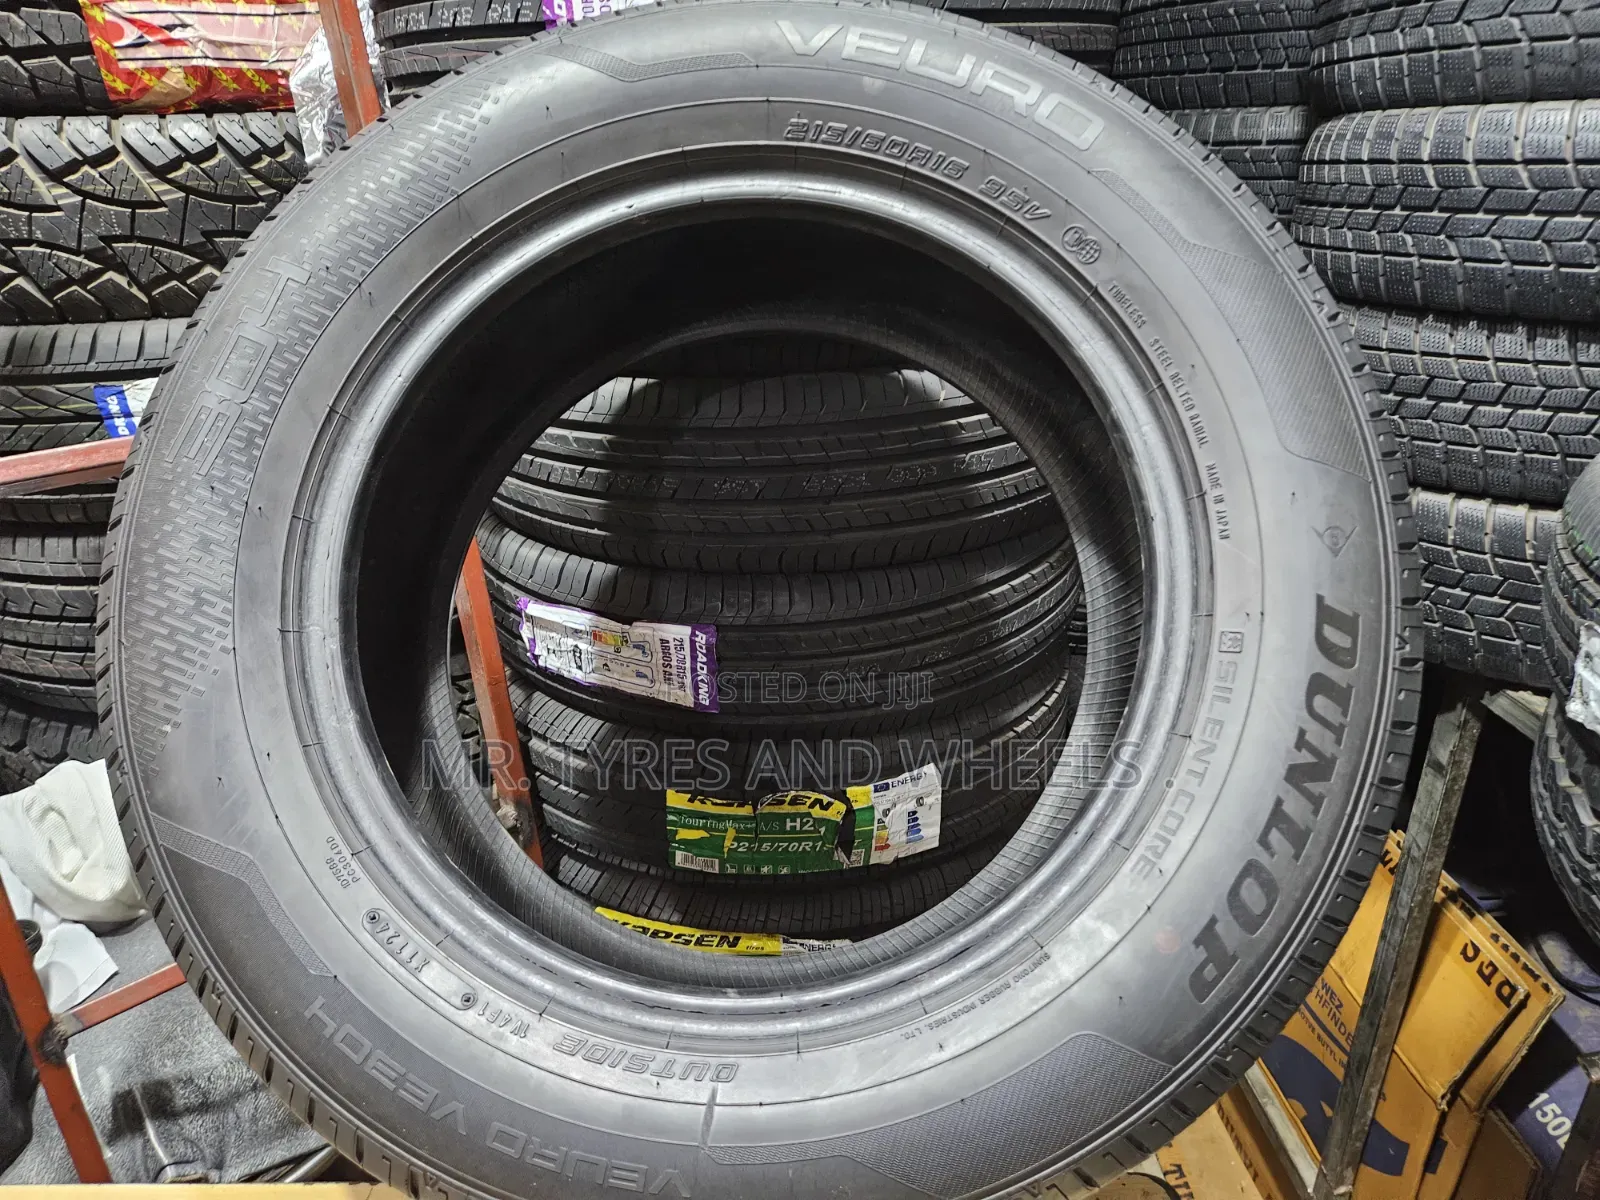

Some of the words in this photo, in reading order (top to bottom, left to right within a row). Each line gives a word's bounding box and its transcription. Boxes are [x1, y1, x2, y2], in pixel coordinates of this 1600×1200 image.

[775, 19, 1105, 151] VEURO
[783, 117, 970, 180] 215/60R16
[978, 174, 1052, 221] 95V
[1107, 283, 1147, 329] TUBELESS
[1149, 337, 1174, 371] STEEL
[1168, 371, 1196, 412] BELTED
[1187, 413, 1209, 448] RADIAL
[1205, 462, 1222, 490] MADE
[1213, 494, 1225, 505] IN
[1215, 509, 1231, 540] JAPAN
[695, 630, 710, 706] ROADKING
[1188, 592, 1362, 1004] DUNLOP
[979, 981, 1012, 1005] RUBBER
[303, 996, 467, 1135] VE304
[553, 1033, 739, 1083] OUTSIDE
[485, 1121, 692, 1198] VEURO
